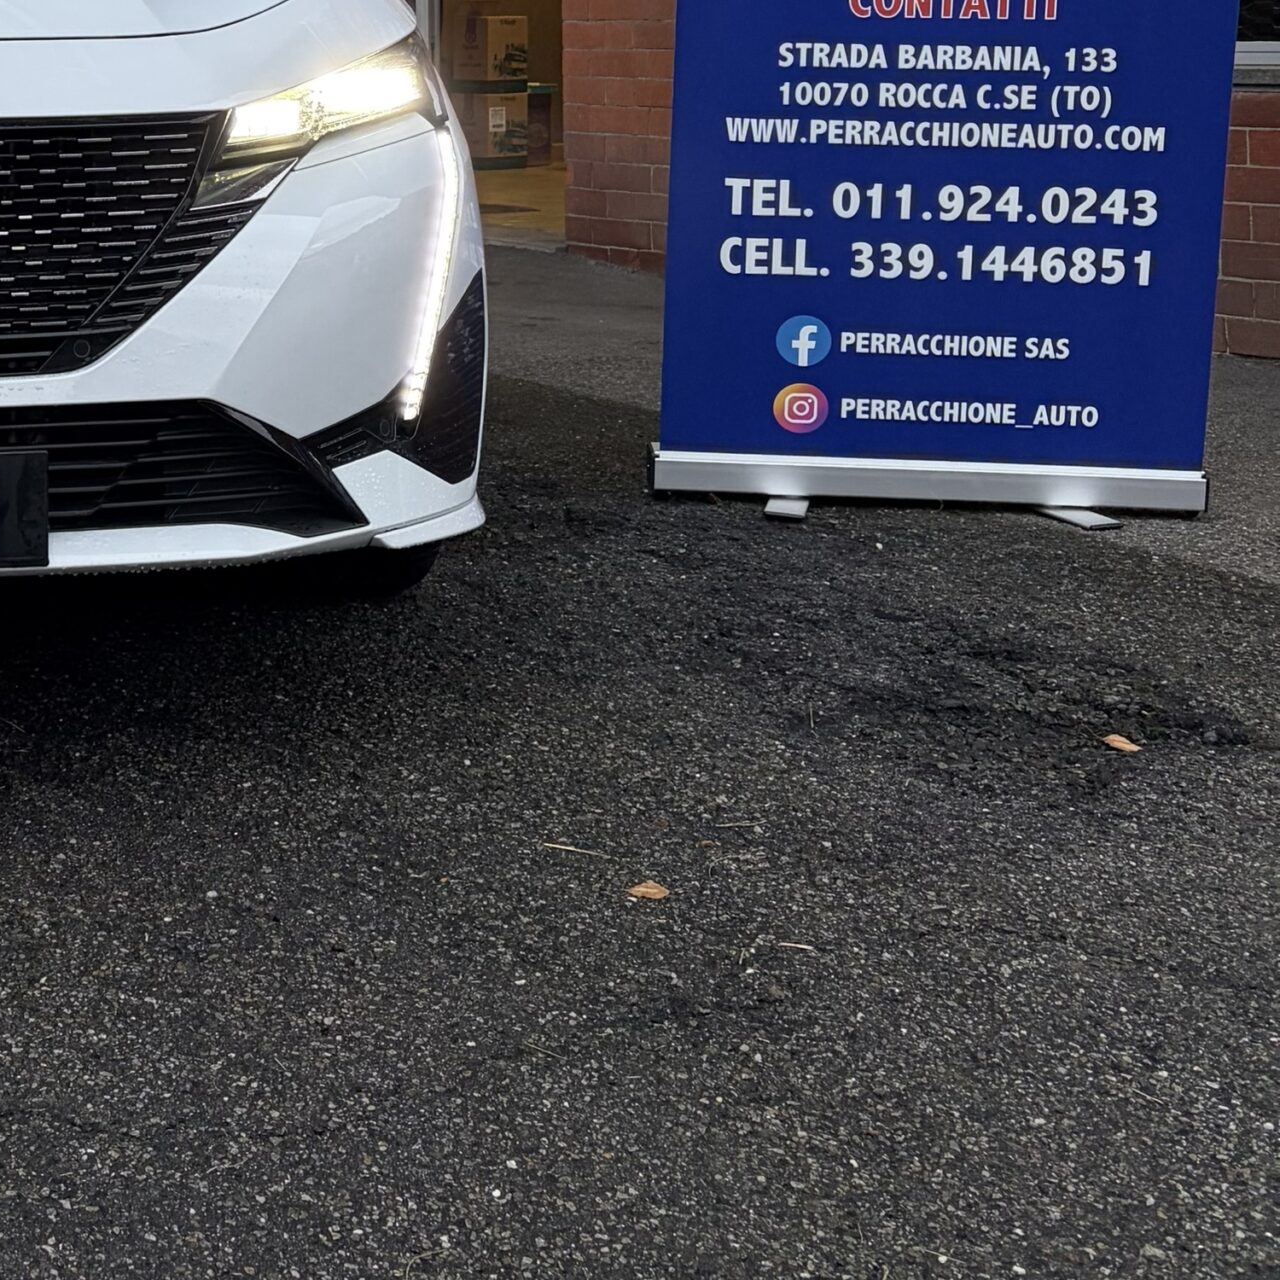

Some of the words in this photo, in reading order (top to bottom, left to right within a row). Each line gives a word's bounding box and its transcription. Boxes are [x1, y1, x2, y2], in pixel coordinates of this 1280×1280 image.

[778, 42, 888, 70] STRADA
[897, 44, 1052, 80] BARBANIA,
[1064, 47, 1118, 73] 133
[779, 81, 869, 108] 10070
[878, 82, 967, 110] ROCCA
[976, 83, 1037, 111] C.SE
[1050, 84, 1113, 118] (TO)
[725, 117, 1166, 153] WWW.PERRACCHIONEAUTO.COM
[724, 177, 815, 217] TEL.
[832, 181, 1159, 227] 011.924.0243
[720, 236, 830, 277] CELL.
[850, 241, 1152, 287] 339.1446851
[840, 331, 1017, 359] PERRACCHIONE
[1024, 336, 1070, 360] SAS
[840, 398, 1099, 428] PERRACCHIONE_AUTO
